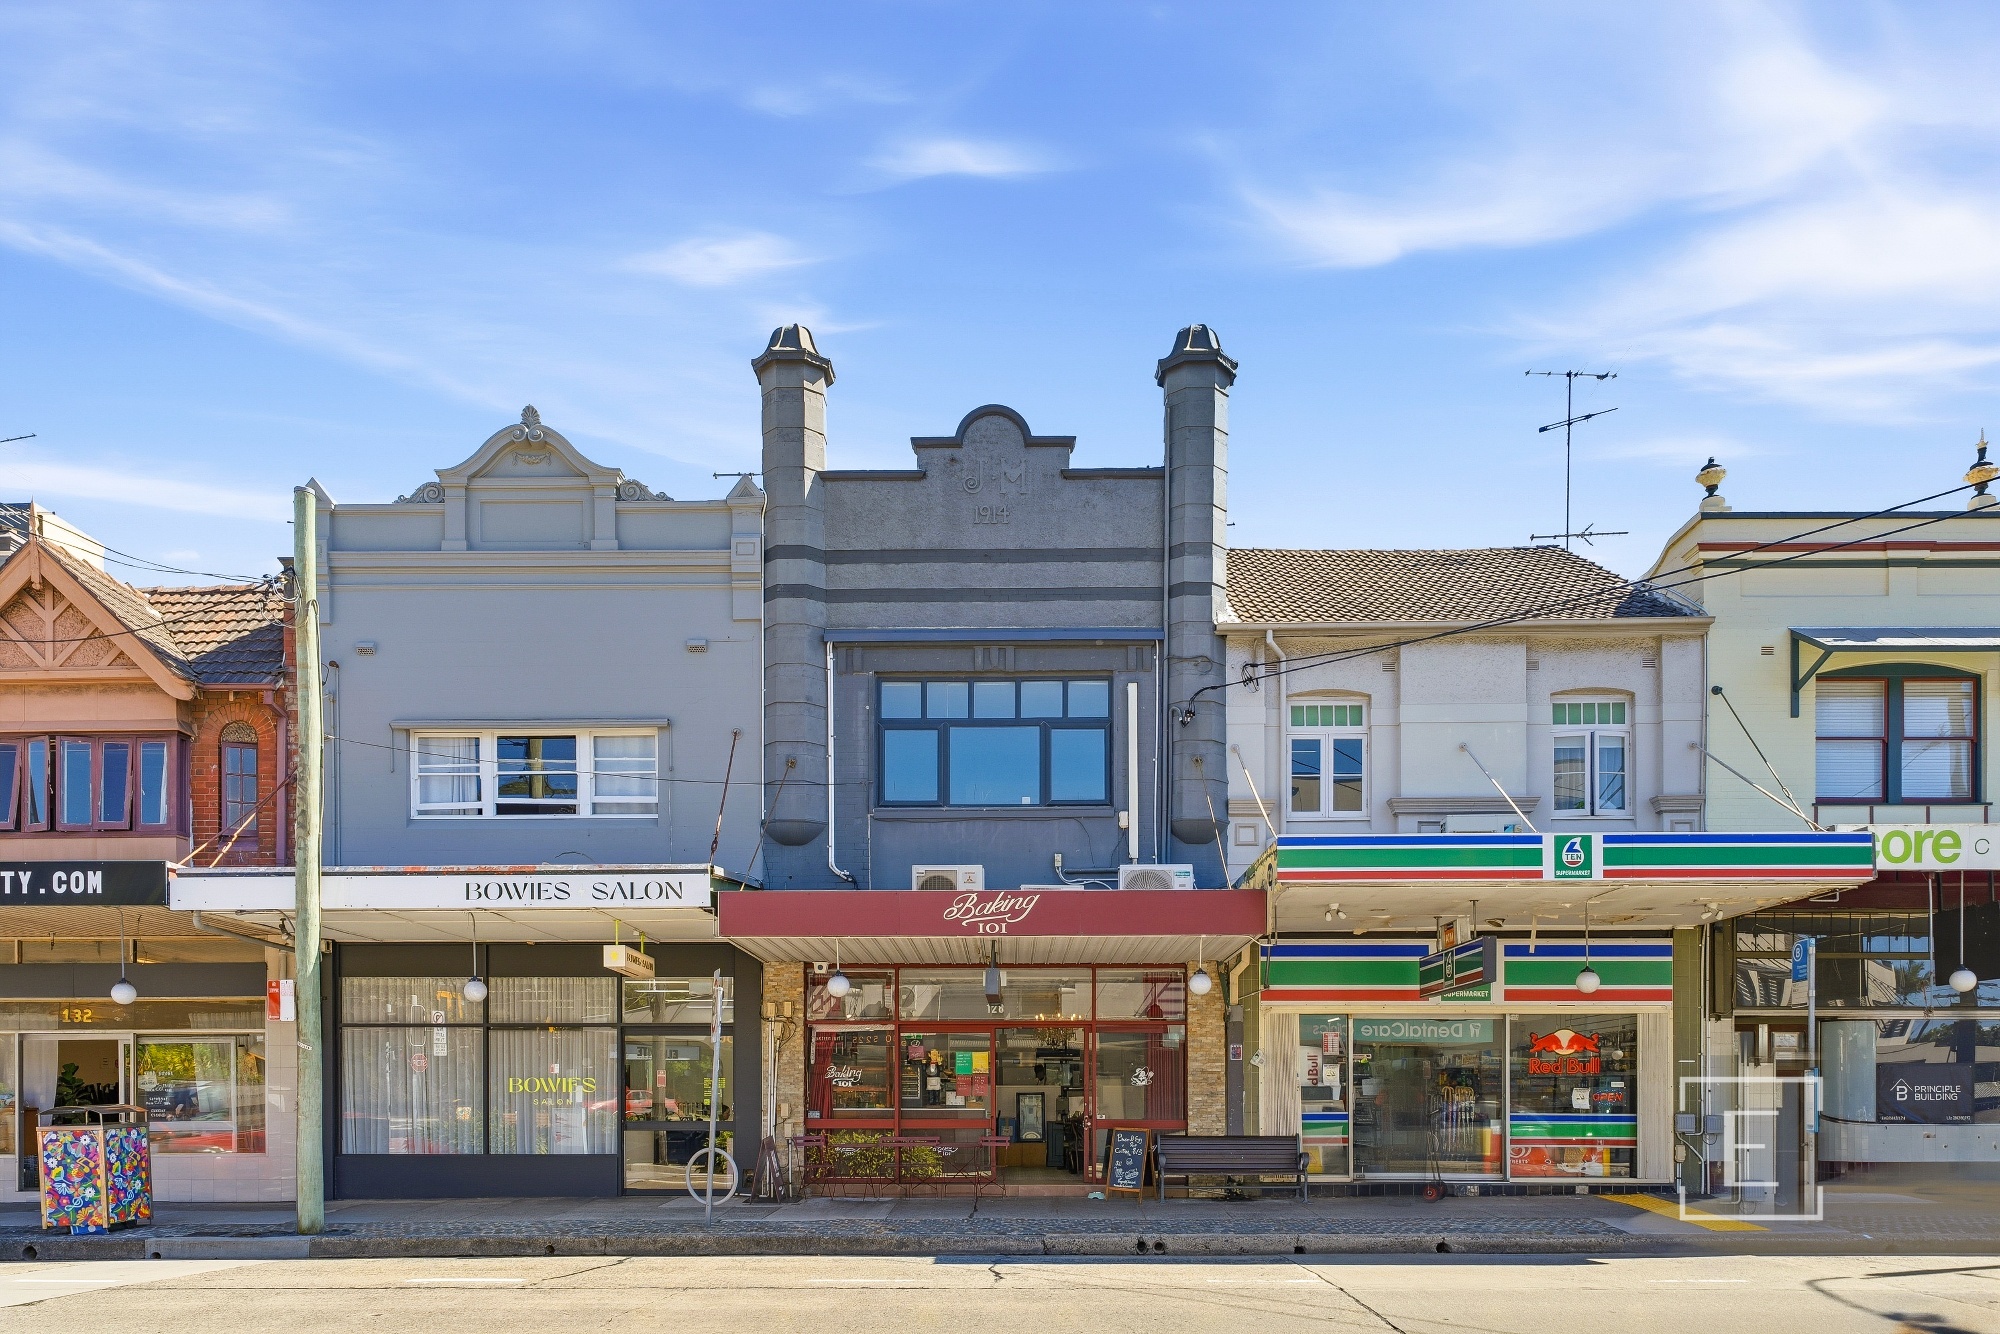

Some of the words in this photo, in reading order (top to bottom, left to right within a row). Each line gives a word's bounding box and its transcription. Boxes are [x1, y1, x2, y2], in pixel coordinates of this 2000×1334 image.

[973, 505, 1010, 524] 1914
[1875, 830, 1962, 864] ore
[0, 871, 103, 894] TY.COM
[465, 881, 571, 900] BOWIES
[592, 881, 683, 900] SALON
[943, 891, 1040, 924] Baking
[62, 1008, 93, 1023] 132
[825, 1065, 863, 1083] Baking
[1528, 1057, 1563, 1075] Red
[1566, 1057, 1602, 1075] Bull
[508, 1077, 597, 1094] BOWIES
[1914, 1085, 1961, 1093] PRINCIPLE
[533, 1098, 573, 1106] SALON
[1592, 1092, 1625, 1102] OPEN
[1914, 1093, 1958, 1101] BUILDING
